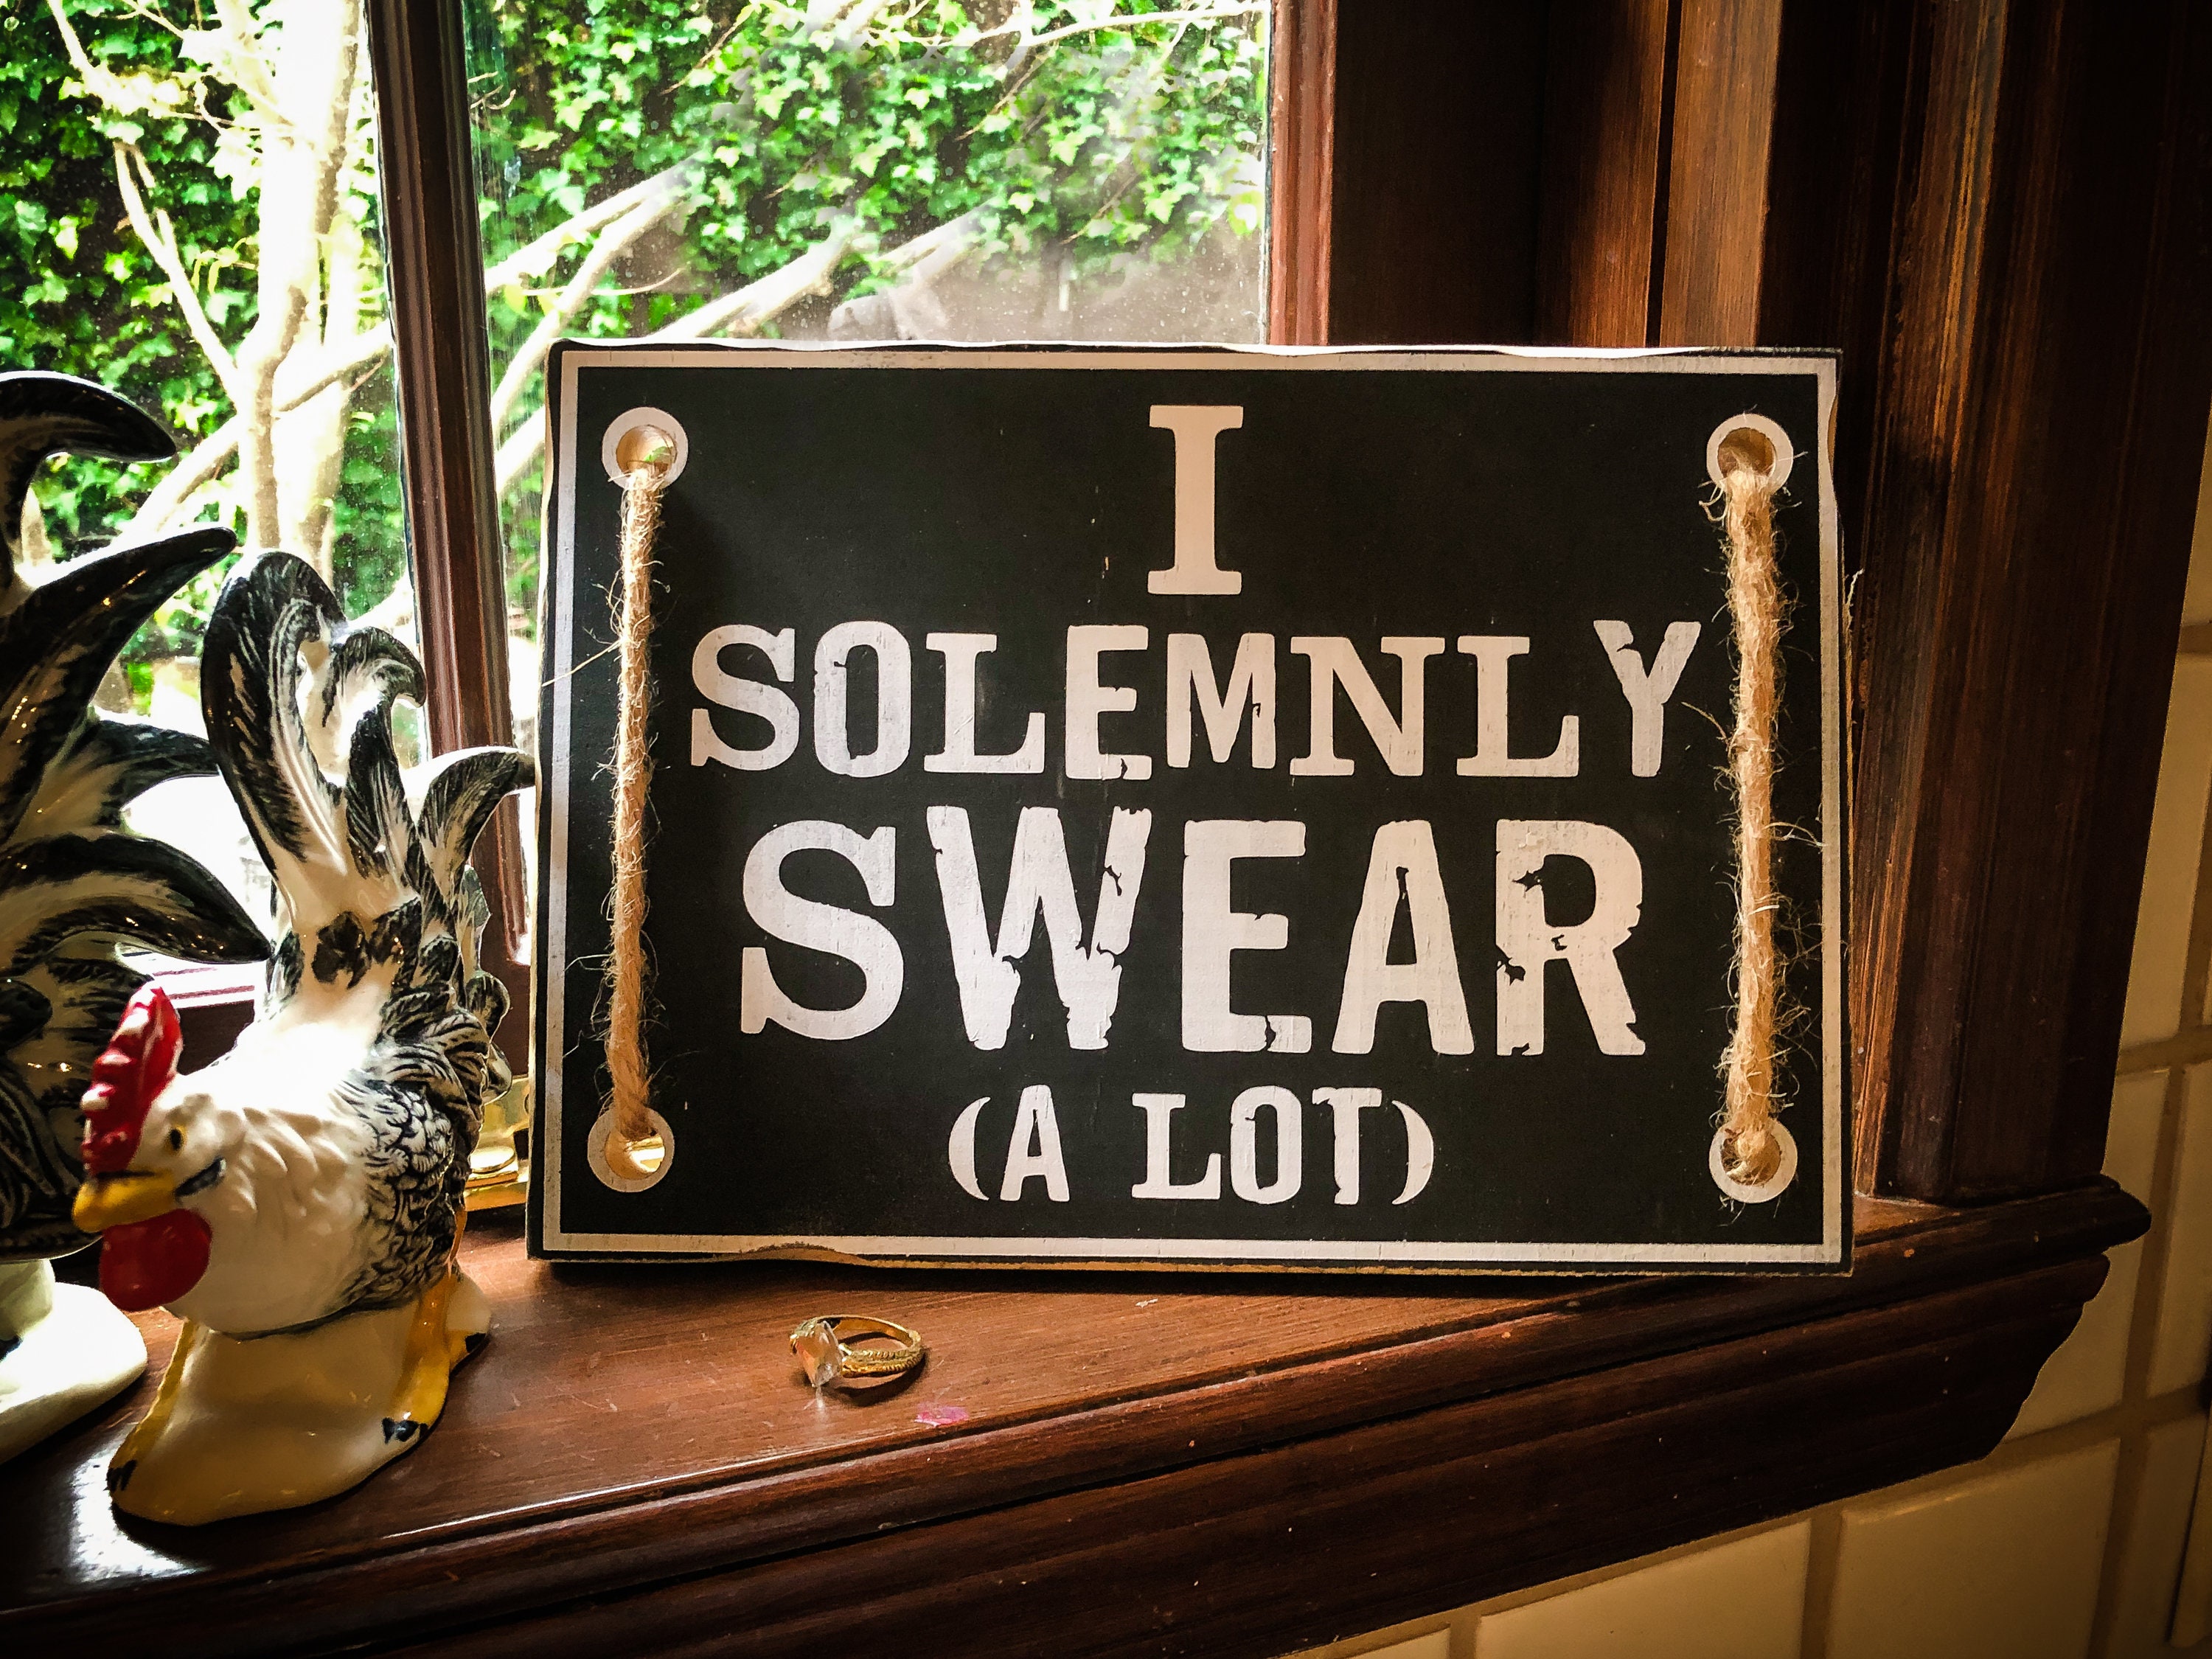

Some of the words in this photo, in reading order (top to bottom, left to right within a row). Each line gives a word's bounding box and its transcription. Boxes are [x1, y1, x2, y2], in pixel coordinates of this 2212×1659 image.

[1147, 405, 1244, 596] I
[691, 619, 1702, 781] SOLEMNLY
[740, 804, 1646, 1056] SWEAR
[948, 1084, 1070, 1203] (A
[1131, 1085, 1434, 1206] LOT)
